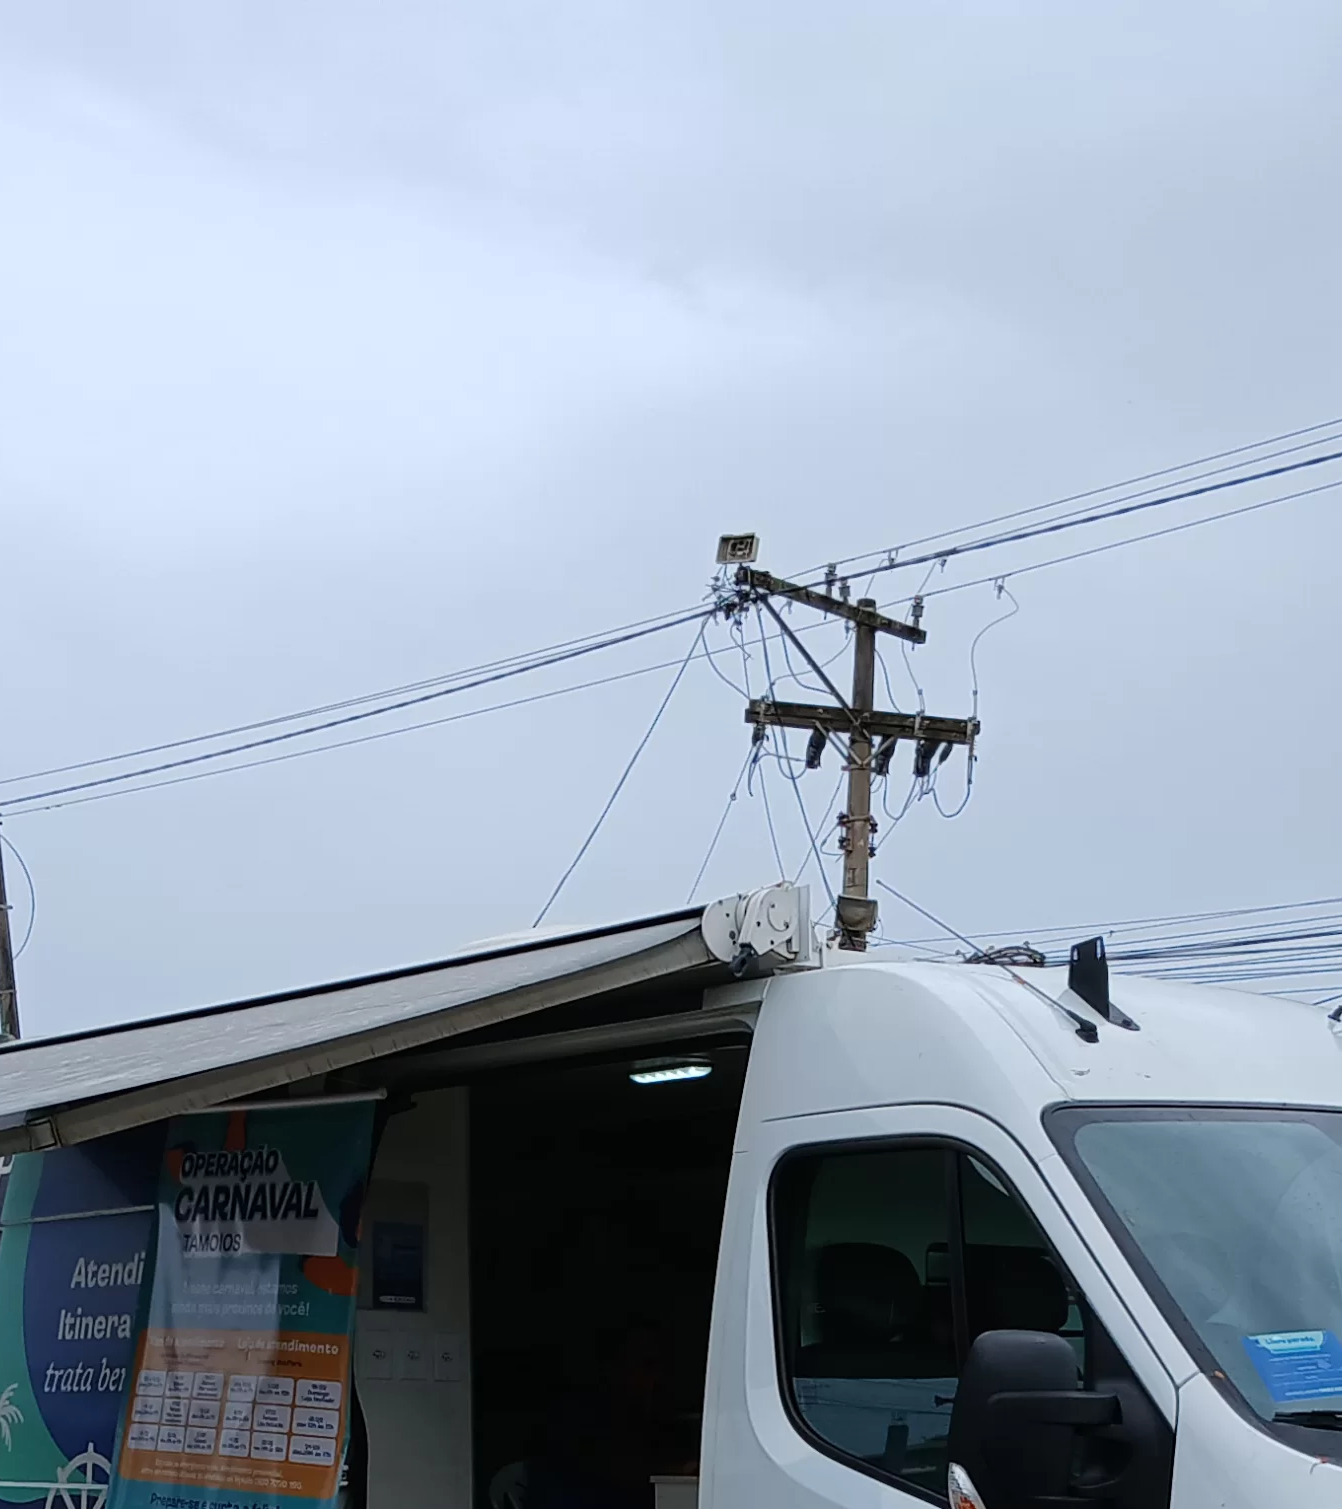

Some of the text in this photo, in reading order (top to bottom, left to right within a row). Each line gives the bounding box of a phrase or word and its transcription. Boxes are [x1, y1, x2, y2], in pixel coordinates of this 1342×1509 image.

[181, 1145, 279, 1181] OPERAÇÃO
[175, 1182, 319, 1221] CARNAVAL
[184, 1233, 242, 1252] TAMOIOS
[278, 1301, 311, 1317] você!
[44, 1362, 94, 1393] trata
